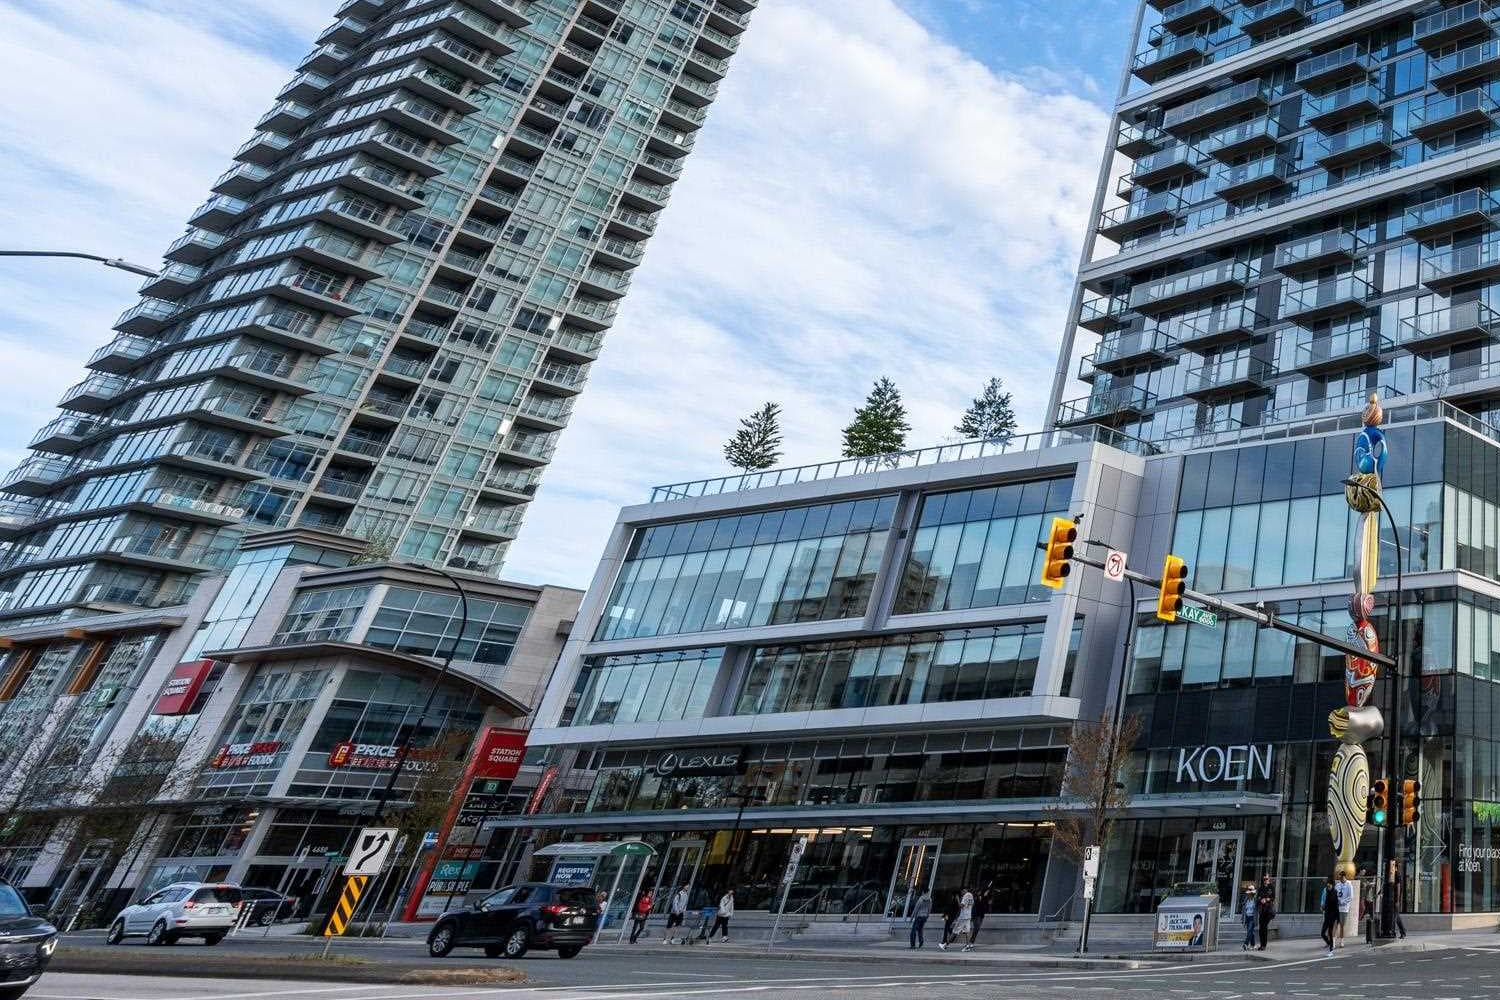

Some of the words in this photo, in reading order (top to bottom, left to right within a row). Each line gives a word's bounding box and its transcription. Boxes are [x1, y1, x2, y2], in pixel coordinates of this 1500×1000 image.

[353, 744, 400, 758] PRICE
[490, 747, 522, 756] STATION
[488, 755, 519, 763] SQUARE
[679, 754, 740, 768] LEXUS
[1176, 744, 1273, 782] KOEN
[557, 867, 591, 875] REGISTER
